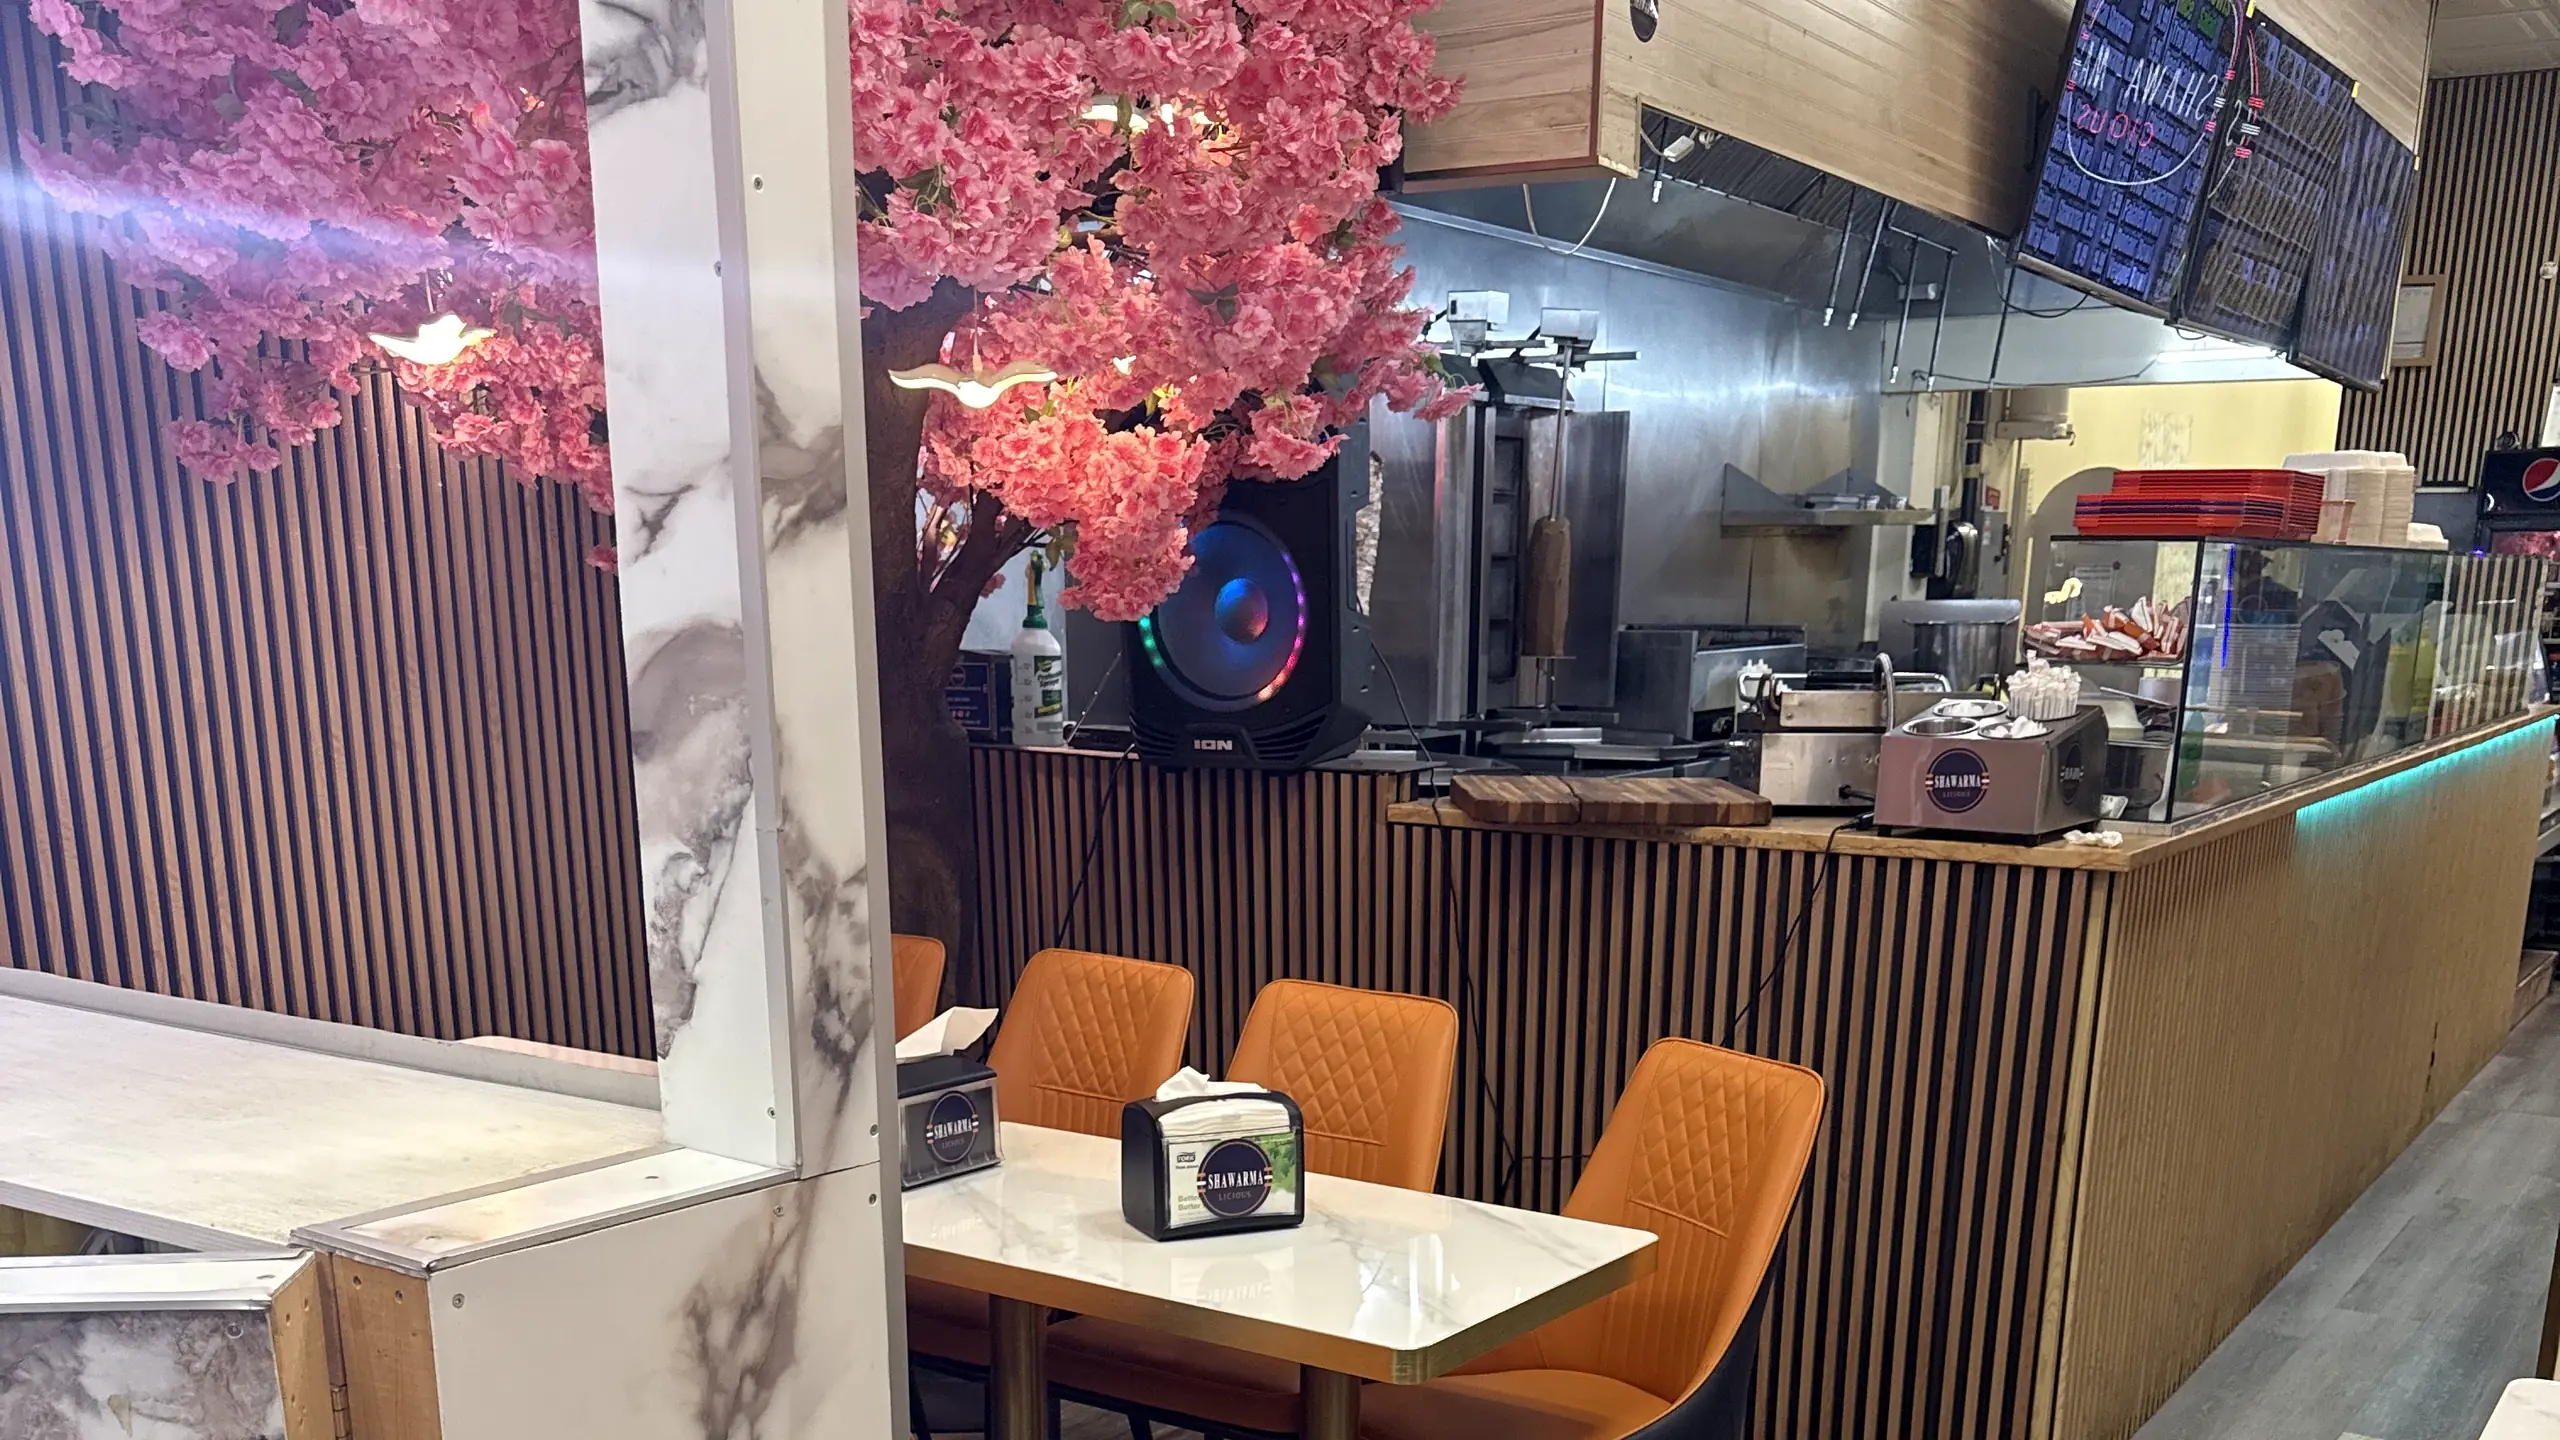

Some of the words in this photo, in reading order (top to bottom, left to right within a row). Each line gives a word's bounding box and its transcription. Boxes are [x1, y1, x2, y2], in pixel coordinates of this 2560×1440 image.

[1194, 740, 1233, 751] ION
[1934, 774, 1981, 789] SHAWARMA
[934, 1118, 972, 1140] SHAWARMA
[1208, 1170, 1263, 1190] SHAWARMA
[1218, 1190, 1252, 1201] LICIOUS
